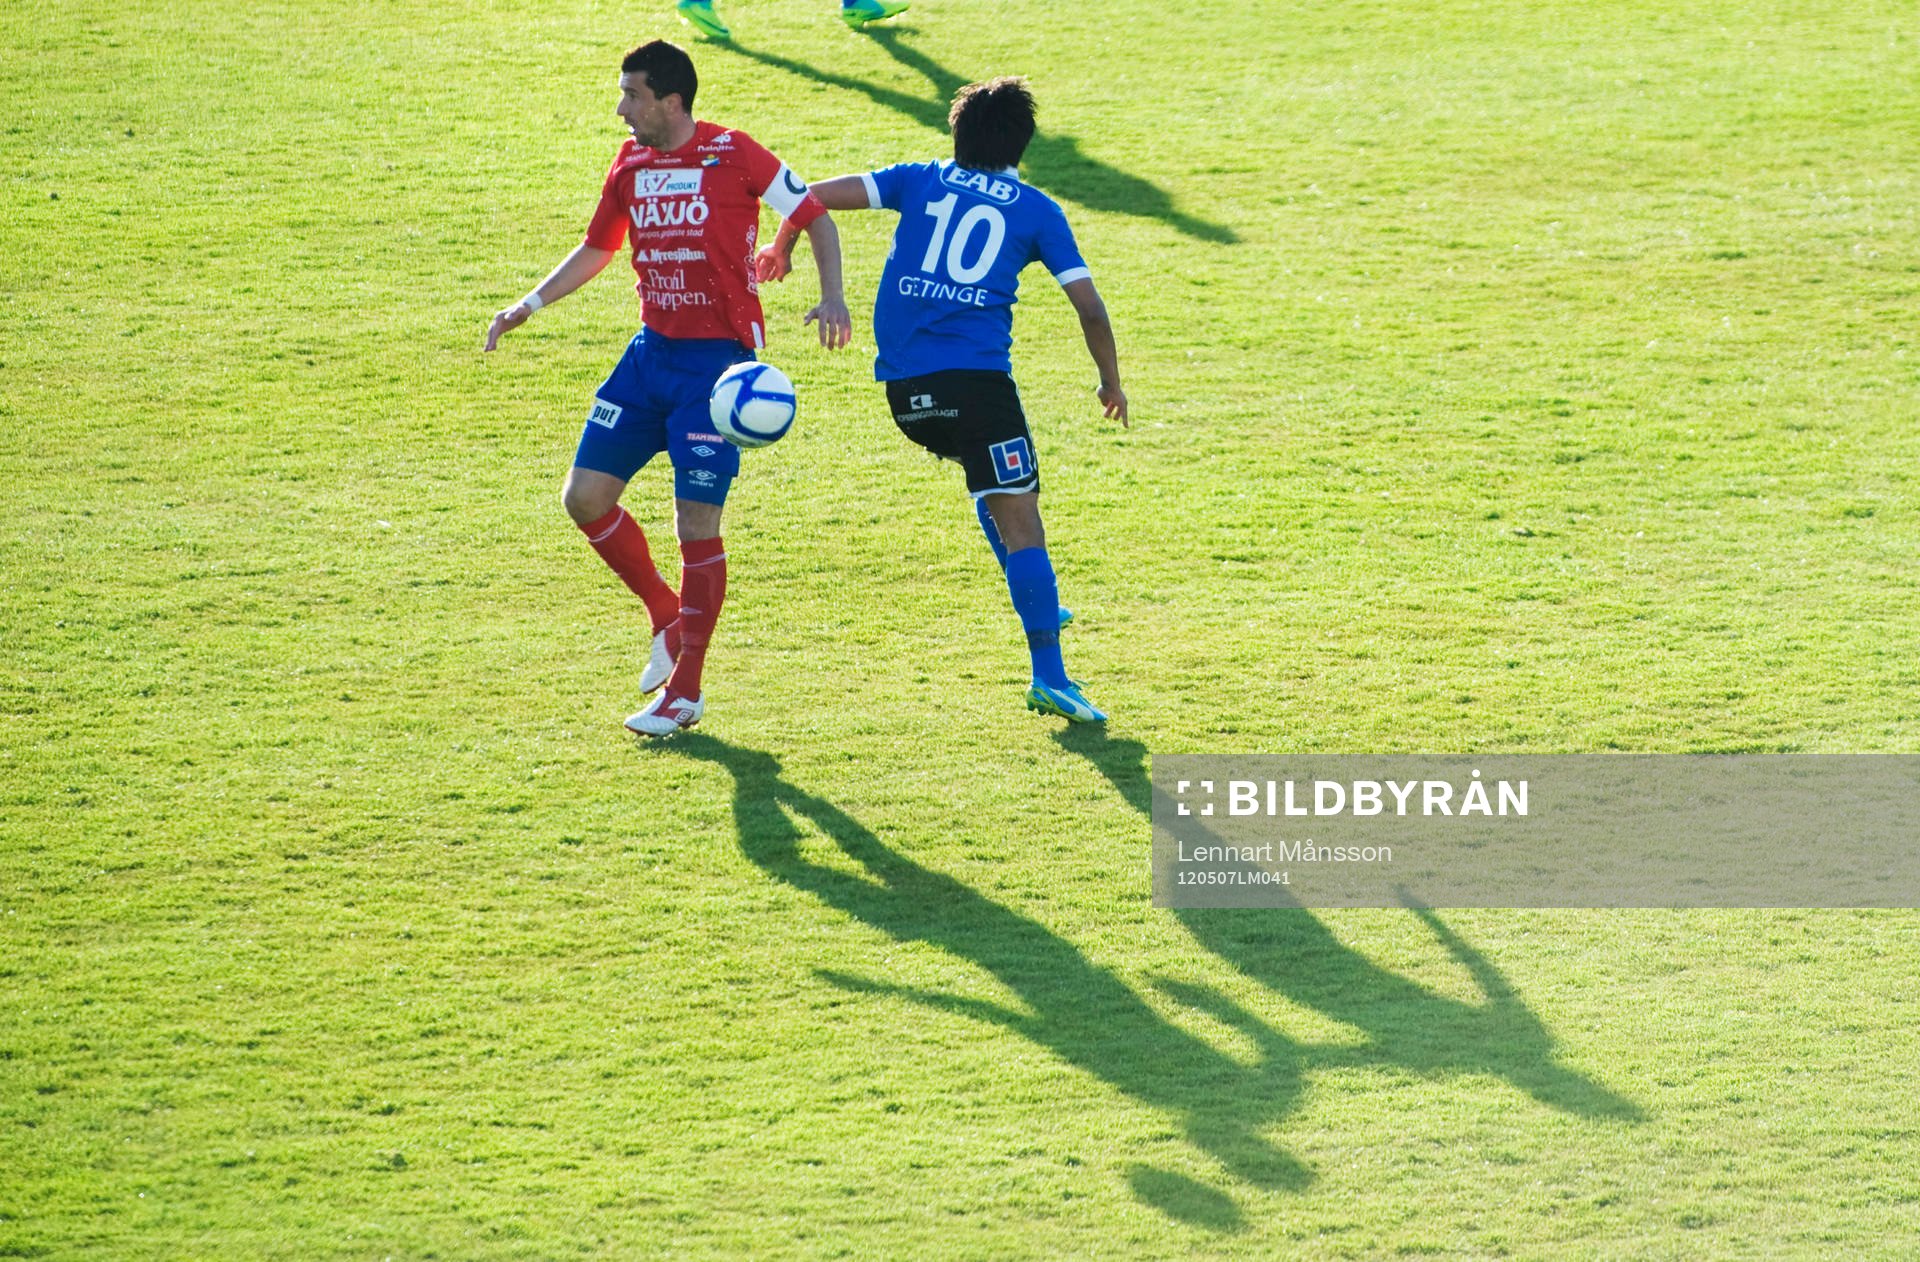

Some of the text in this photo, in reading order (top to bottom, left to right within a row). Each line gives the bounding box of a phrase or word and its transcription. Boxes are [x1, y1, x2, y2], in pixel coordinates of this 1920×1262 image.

[666, 182, 698, 192] PRODUKT
[785, 168, 808, 195] C
[946, 167, 1013, 201] EAB
[630, 195, 709, 229] VÄXJÖ
[686, 228, 704, 237] stad
[921, 192, 1006, 285] 10
[648, 269, 686, 290] Profil
[898, 275, 989, 308] GETINGE
[591, 405, 617, 424] put
